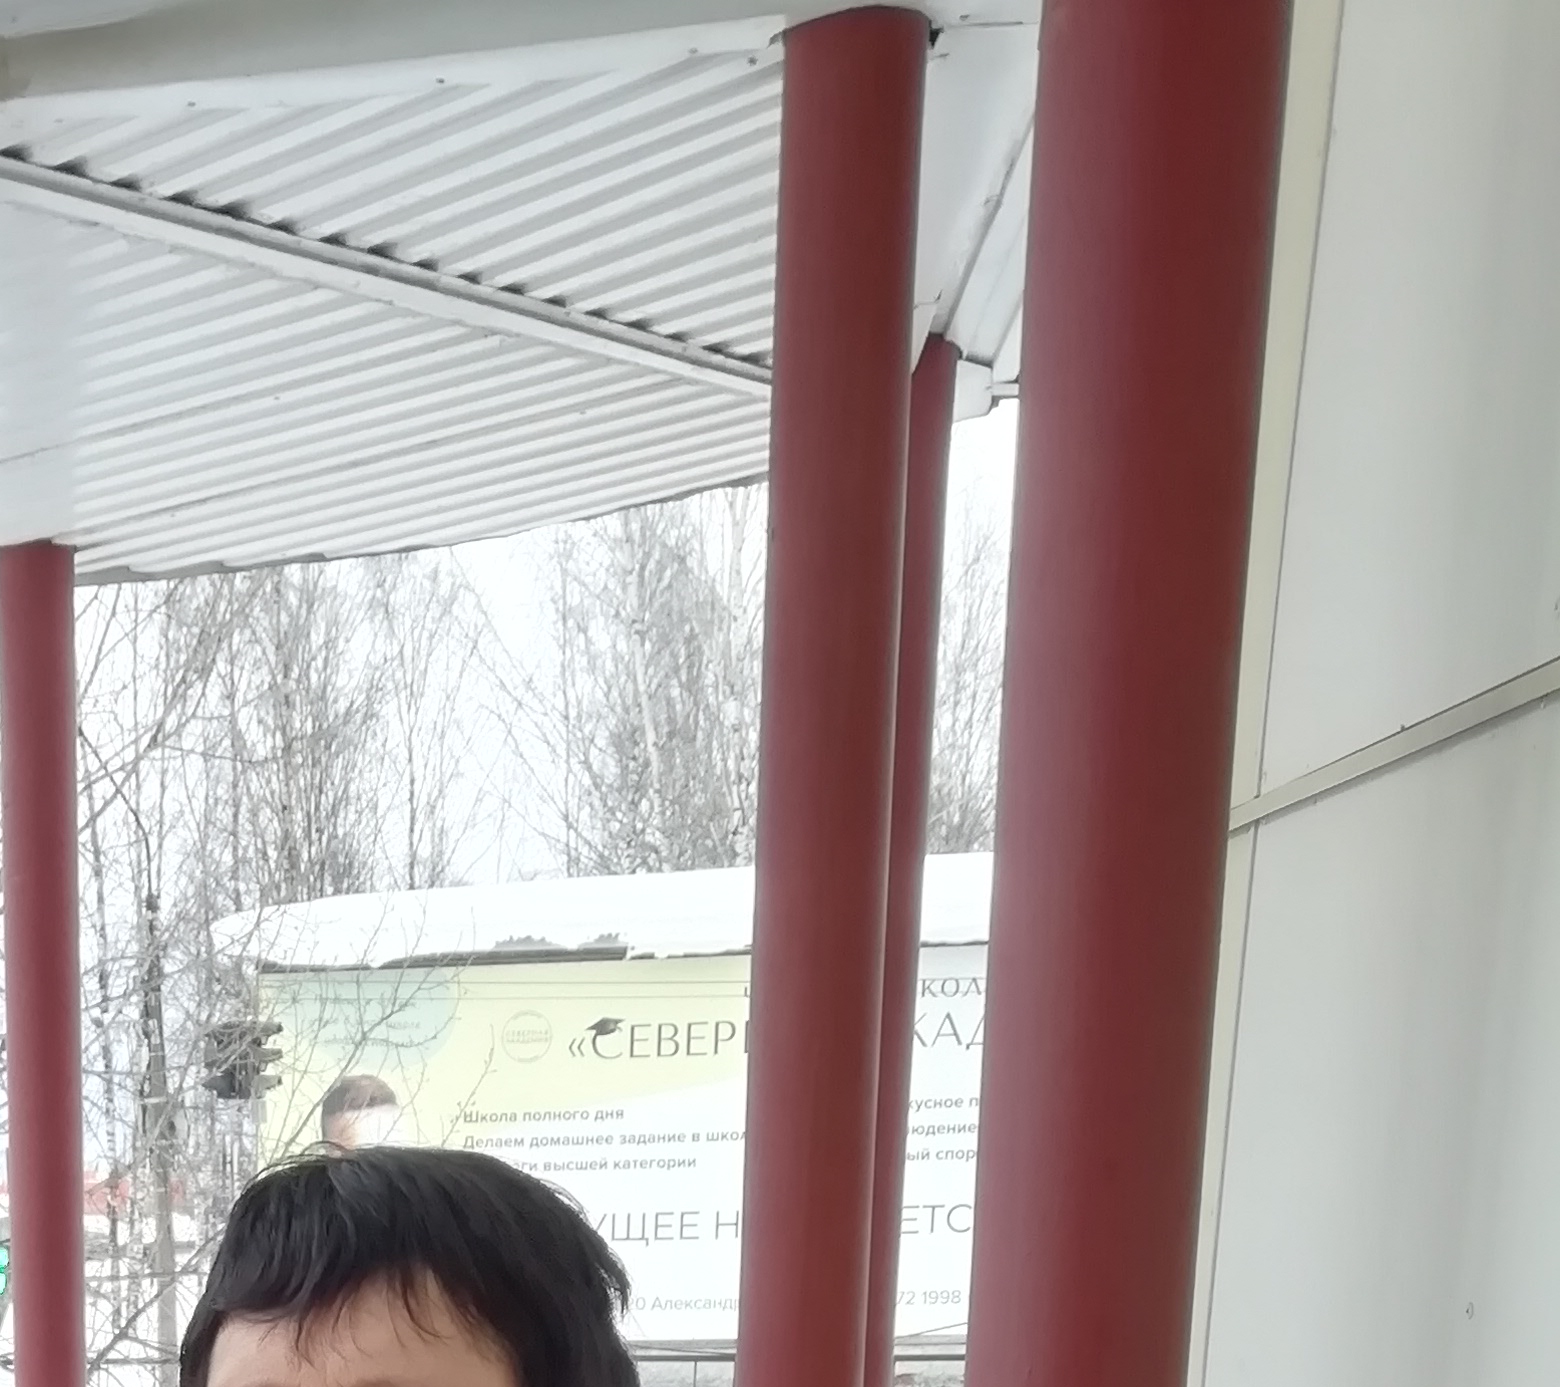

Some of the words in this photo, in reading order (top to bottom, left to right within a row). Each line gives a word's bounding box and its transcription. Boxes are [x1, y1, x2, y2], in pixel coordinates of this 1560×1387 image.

[921, 978, 982, 998] КОЛ
[568, 1019, 749, 1060] «СЕВЕР
[463, 1110, 517, 1124] Школа
[523, 1109, 589, 1123] полного
[594, 1108, 624, 1123] дня
[908, 1097, 964, 1113] кусное
[463, 1136, 525, 1150] Делаем
[529, 1134, 613, 1149] домашнее
[619, 1132, 686, 1146] задание
[692, 1132, 700, 1143] в
[910, 1123, 977, 1138] юдение
[543, 1157, 608, 1171] высшей
[613, 1156, 697, 1172] категории
[906, 1147, 930, 1161] ый
[935, 1149, 976, 1162] спор
[901, 1204, 972, 1234] ЕТС
[922, 1290, 962, 1305] 1998
